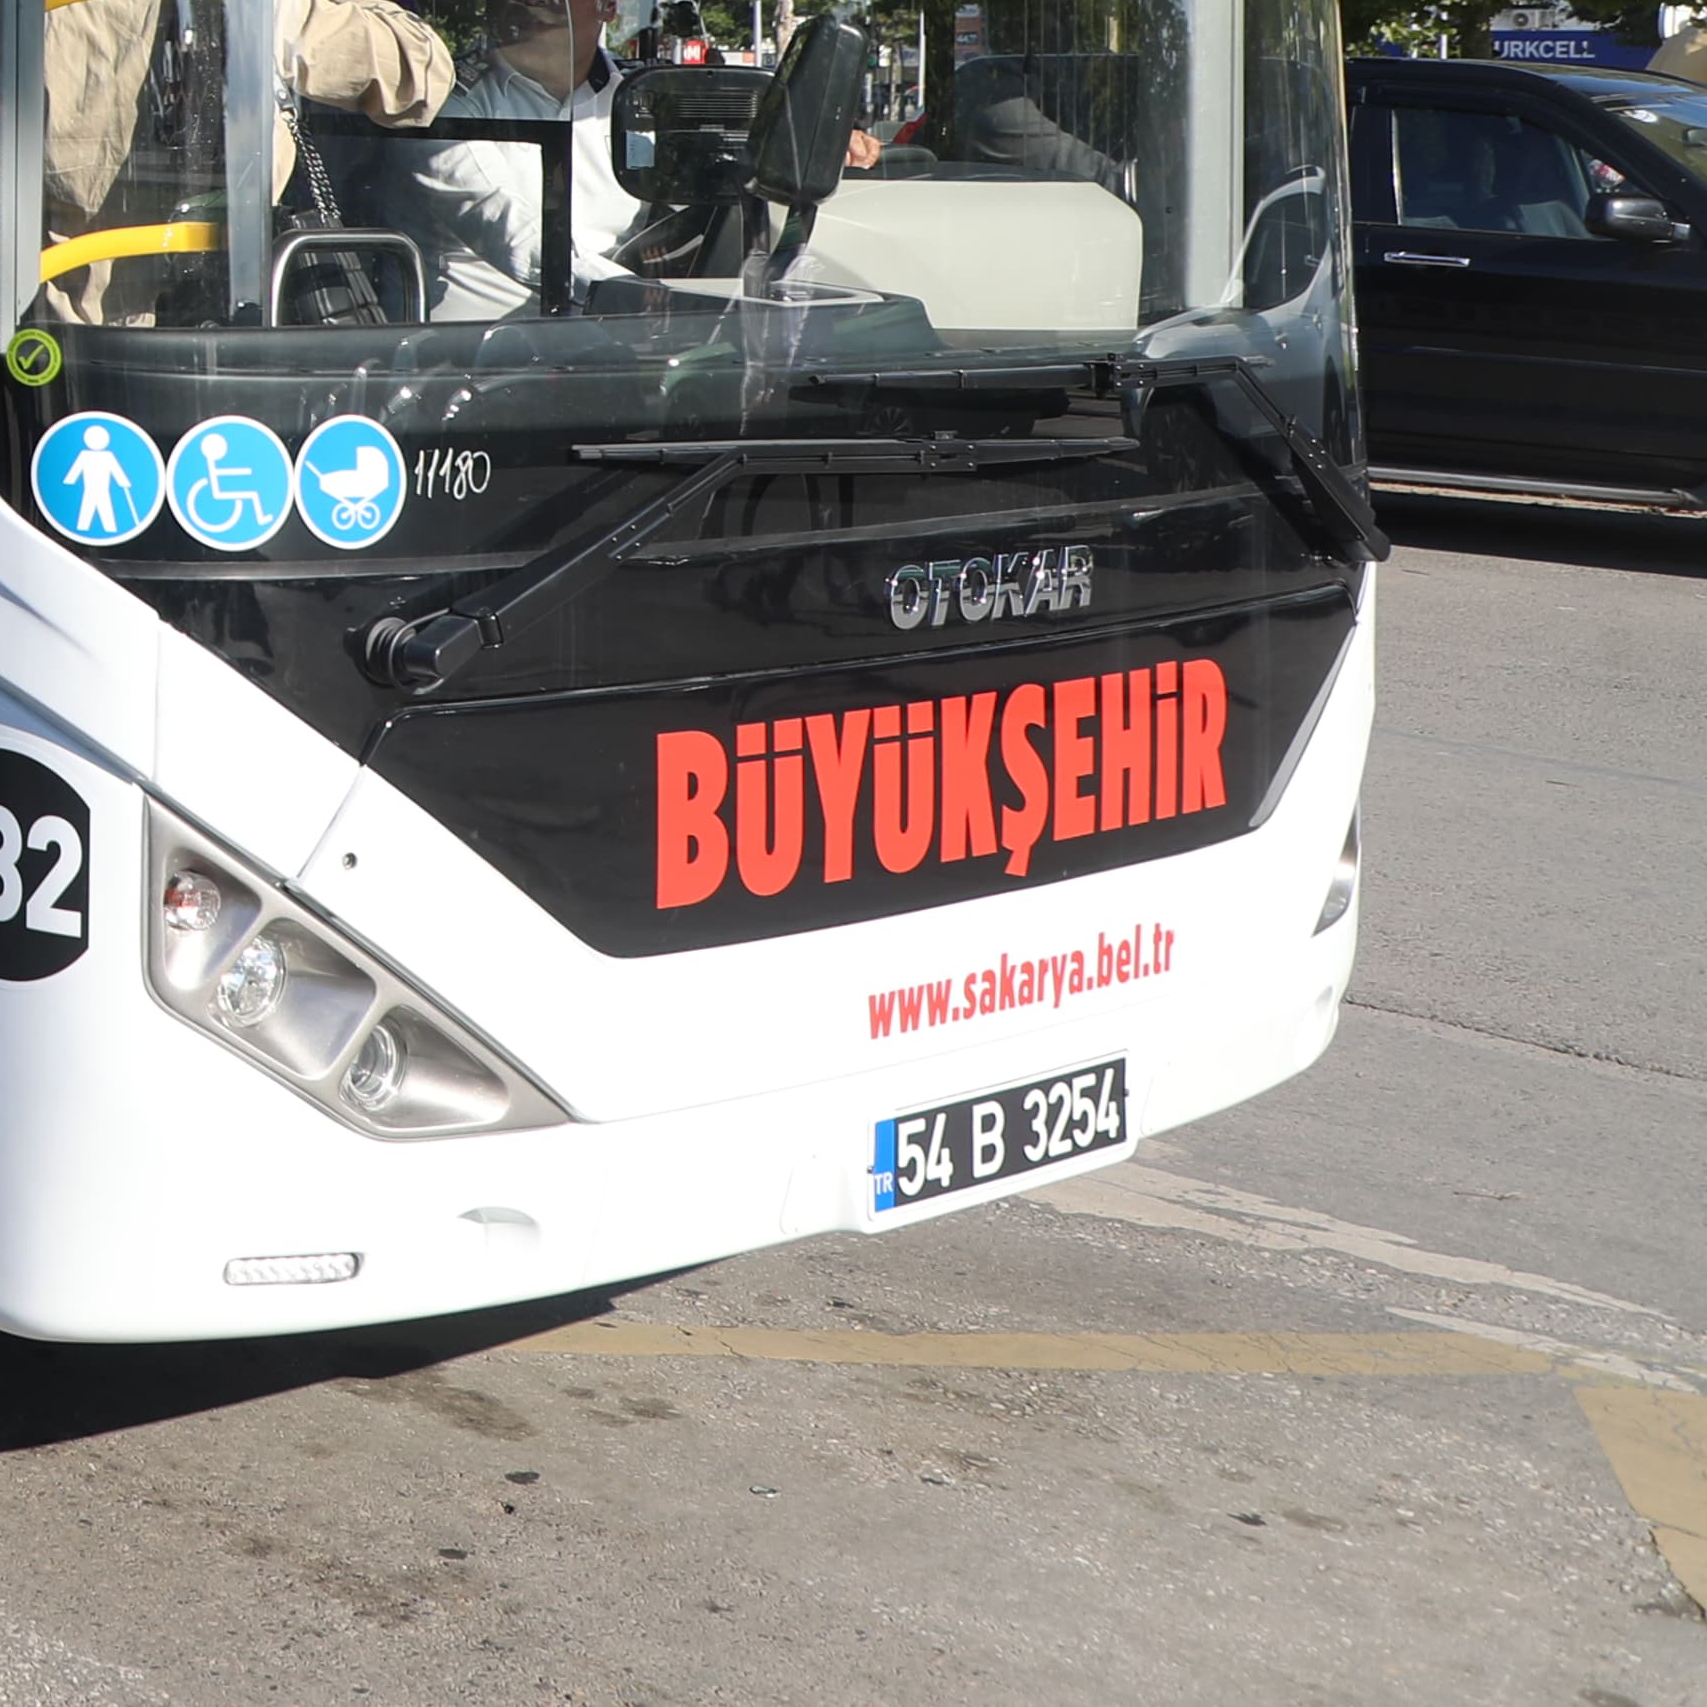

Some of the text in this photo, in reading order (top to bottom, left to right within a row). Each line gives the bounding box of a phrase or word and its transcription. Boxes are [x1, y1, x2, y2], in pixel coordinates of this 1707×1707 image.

[1493, 40, 1596, 58] URKCELL
[888, 545, 1093, 630] OTOKAR
[867, 922, 1175, 1040] www.sakarya.bel.tr
[875, 1068, 1120, 1196] TR 54 B 3254
